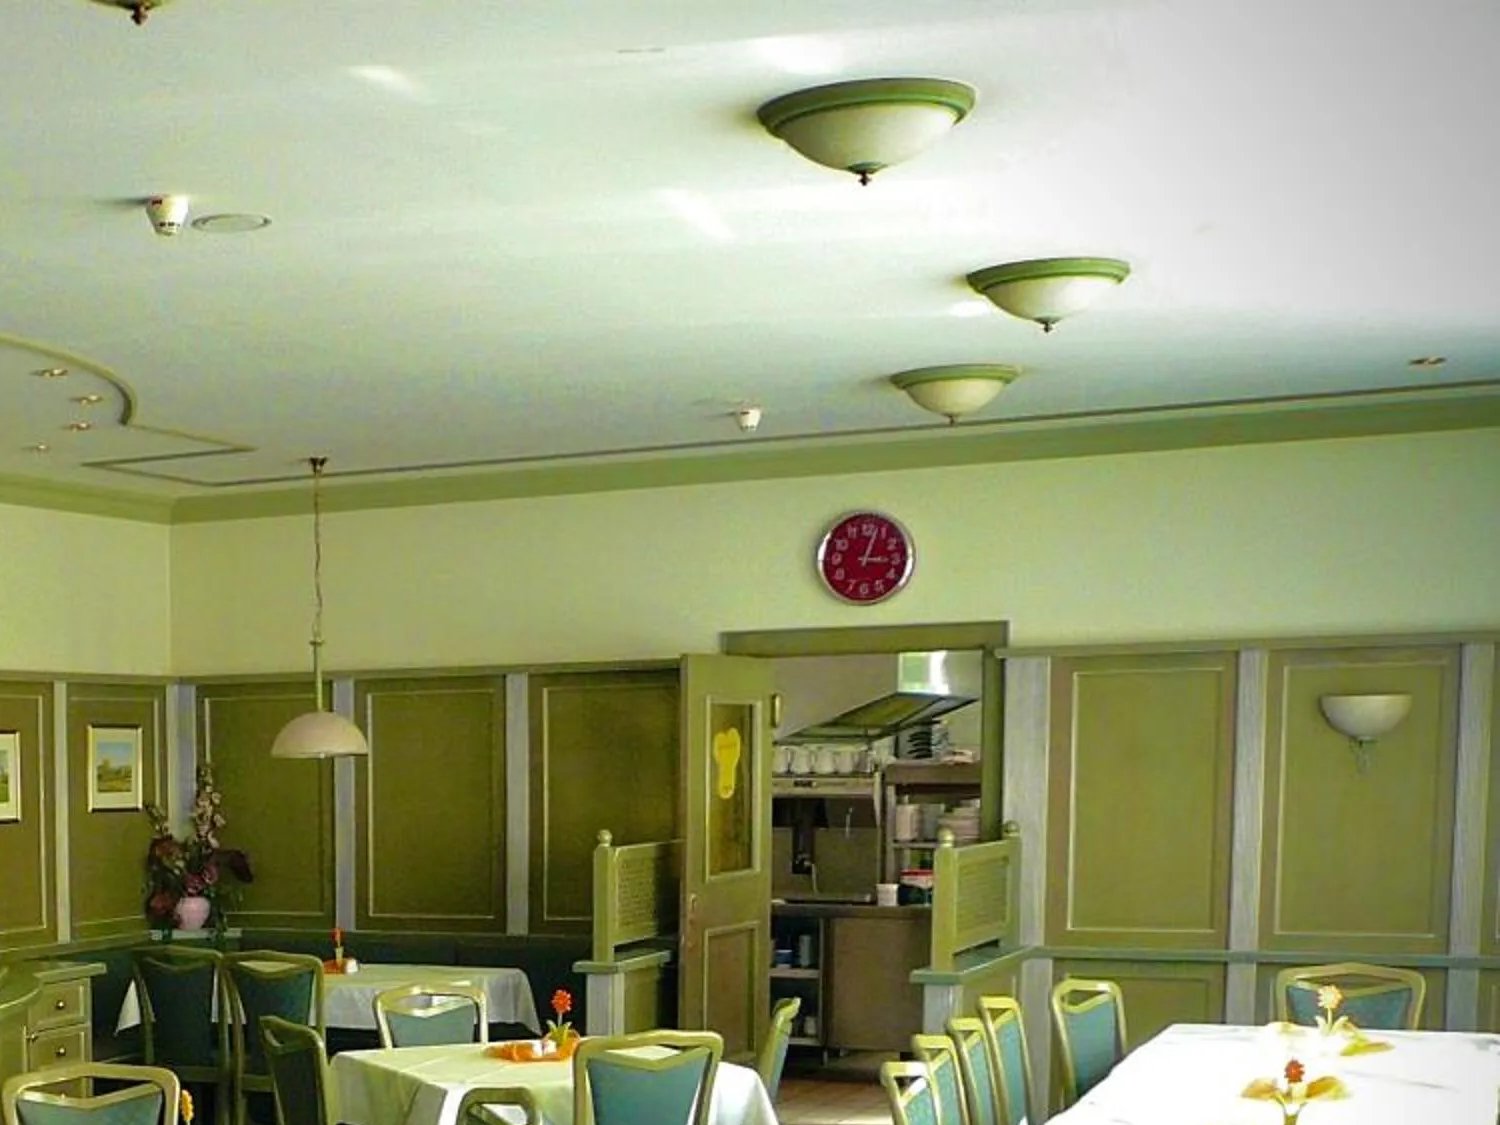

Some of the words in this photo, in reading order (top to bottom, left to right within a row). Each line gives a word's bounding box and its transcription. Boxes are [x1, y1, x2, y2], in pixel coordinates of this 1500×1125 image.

[861, 523, 876, 537] 12
[834, 538, 849, 552] 10
[887, 537, 897, 551] 2
[831, 552, 843, 566] 9
[891, 552, 901, 566] 3
[886, 567, 896, 579] 4
[859, 583, 869, 597] 6
